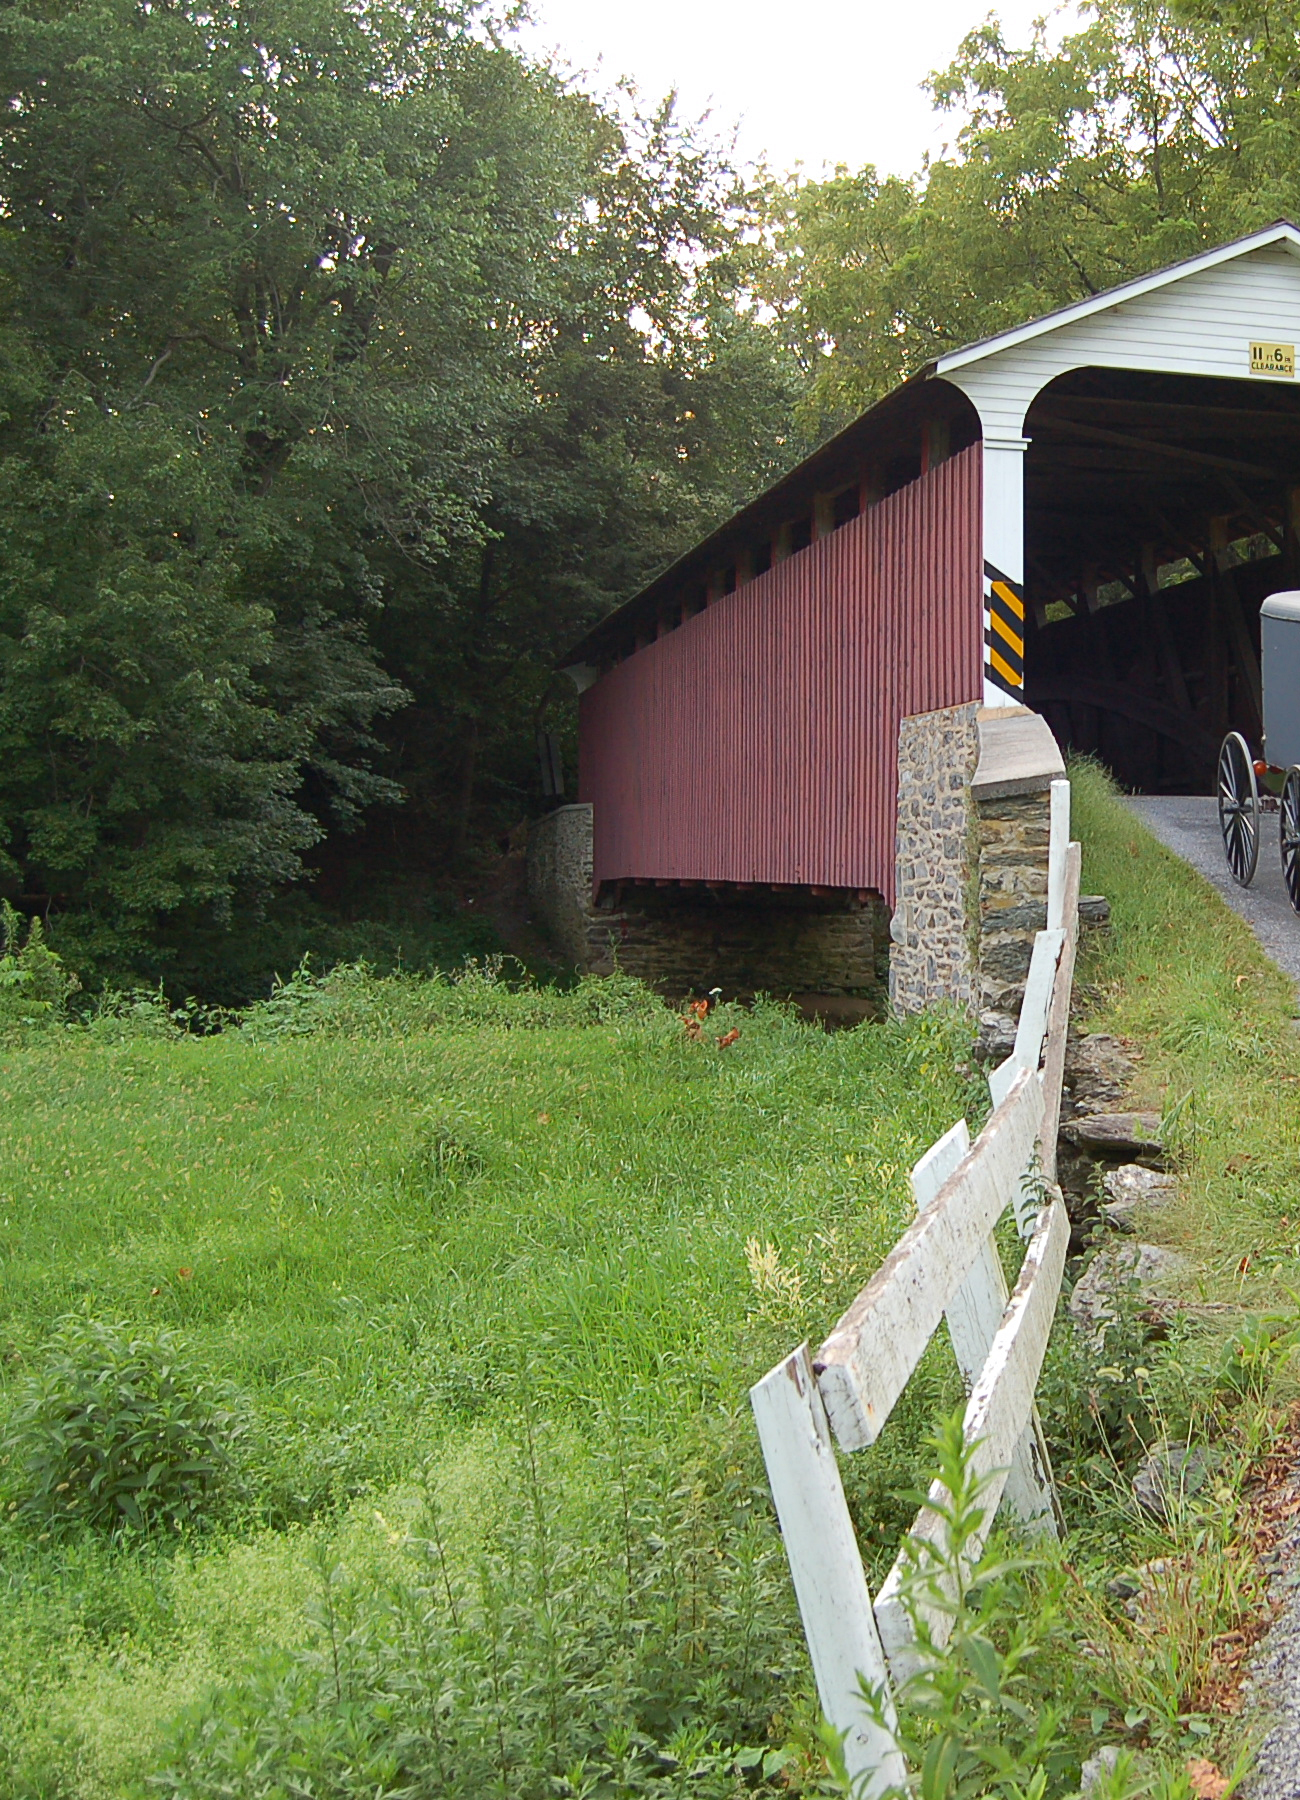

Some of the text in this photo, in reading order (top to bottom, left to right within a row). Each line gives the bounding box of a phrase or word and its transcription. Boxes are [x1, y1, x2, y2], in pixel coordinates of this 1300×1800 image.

[1253, 347, 1262, 360] 11
[1274, 348, 1283, 362] 6
[1252, 362, 1292, 372] CLEARANCE
